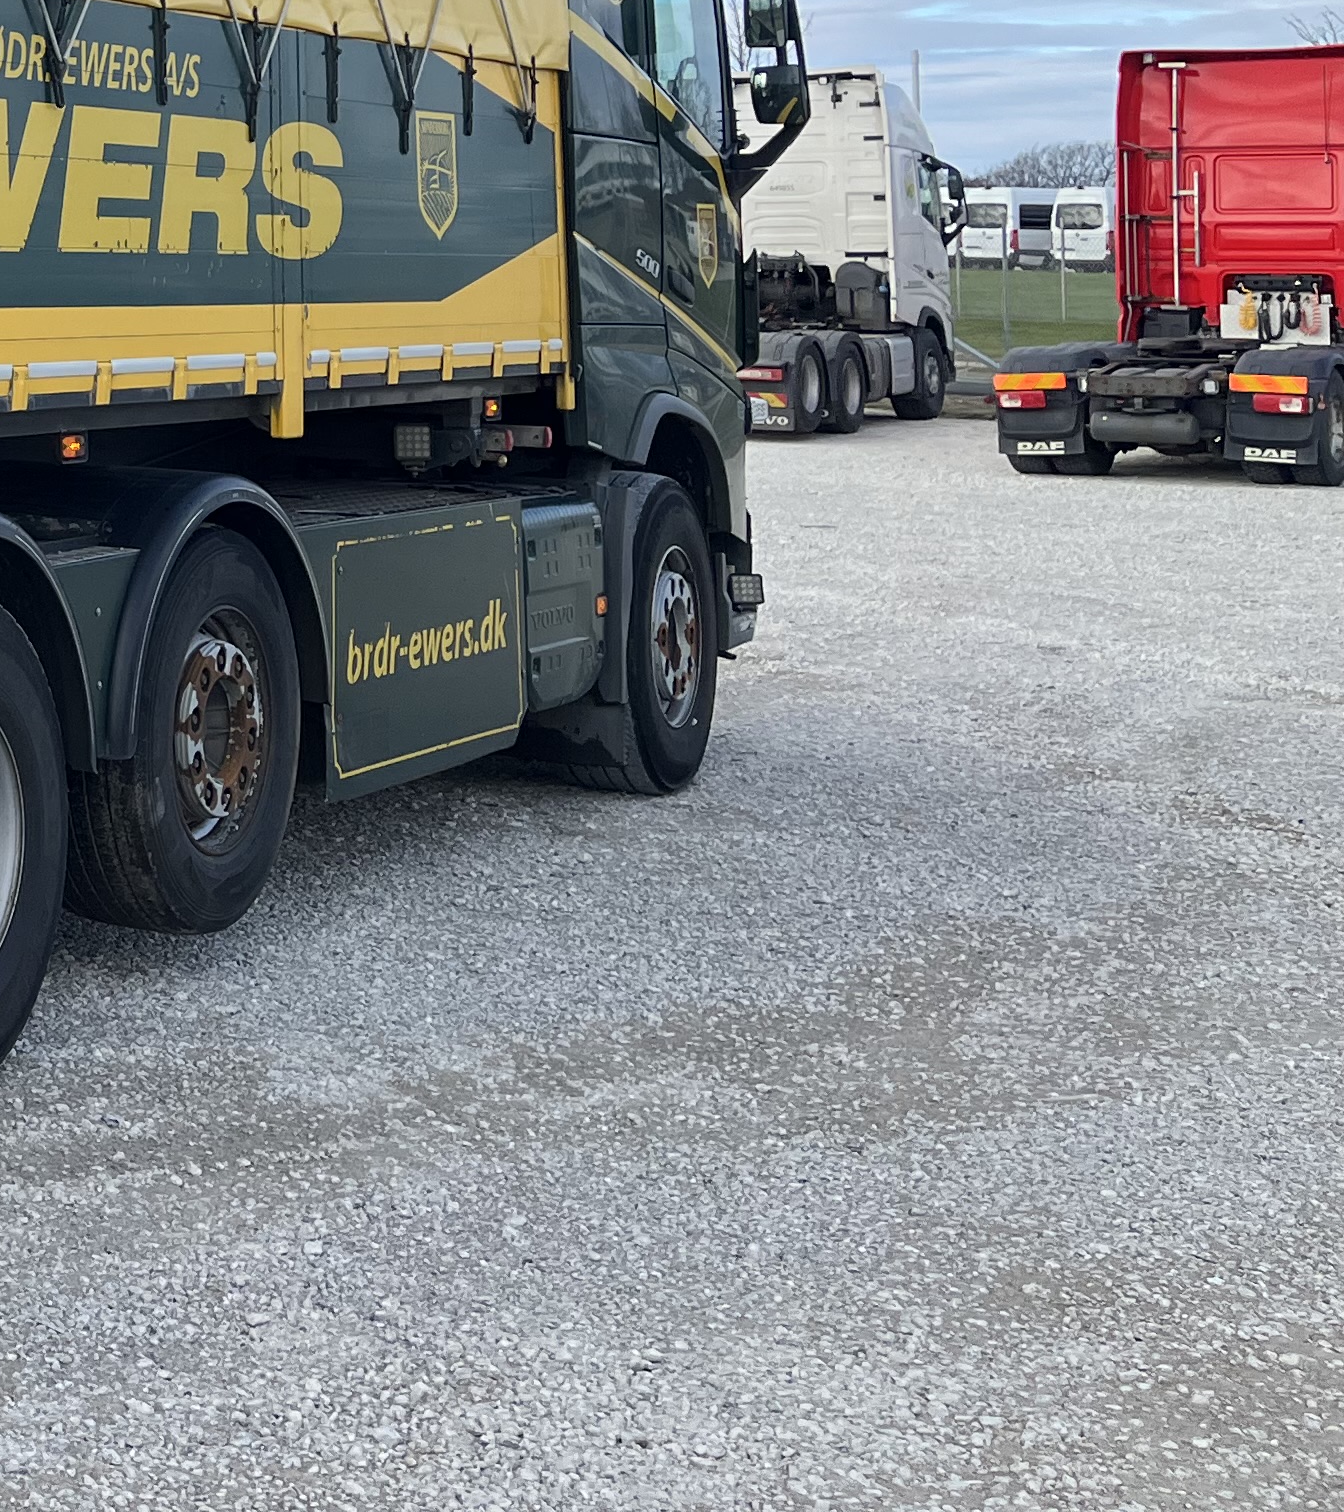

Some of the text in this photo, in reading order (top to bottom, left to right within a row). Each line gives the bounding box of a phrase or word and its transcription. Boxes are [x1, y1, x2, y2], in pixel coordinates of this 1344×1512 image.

[62, 39, 154, 93] EWERS
[165, 50, 201, 98] A/S
[635, 248, 660, 278] 500
[1016, 440, 1065, 451] DAF
[1244, 446, 1297, 459] DAF
[530, 604, 574, 629] VOLVO
[346, 598, 507, 685] brdr-ewers.dk
